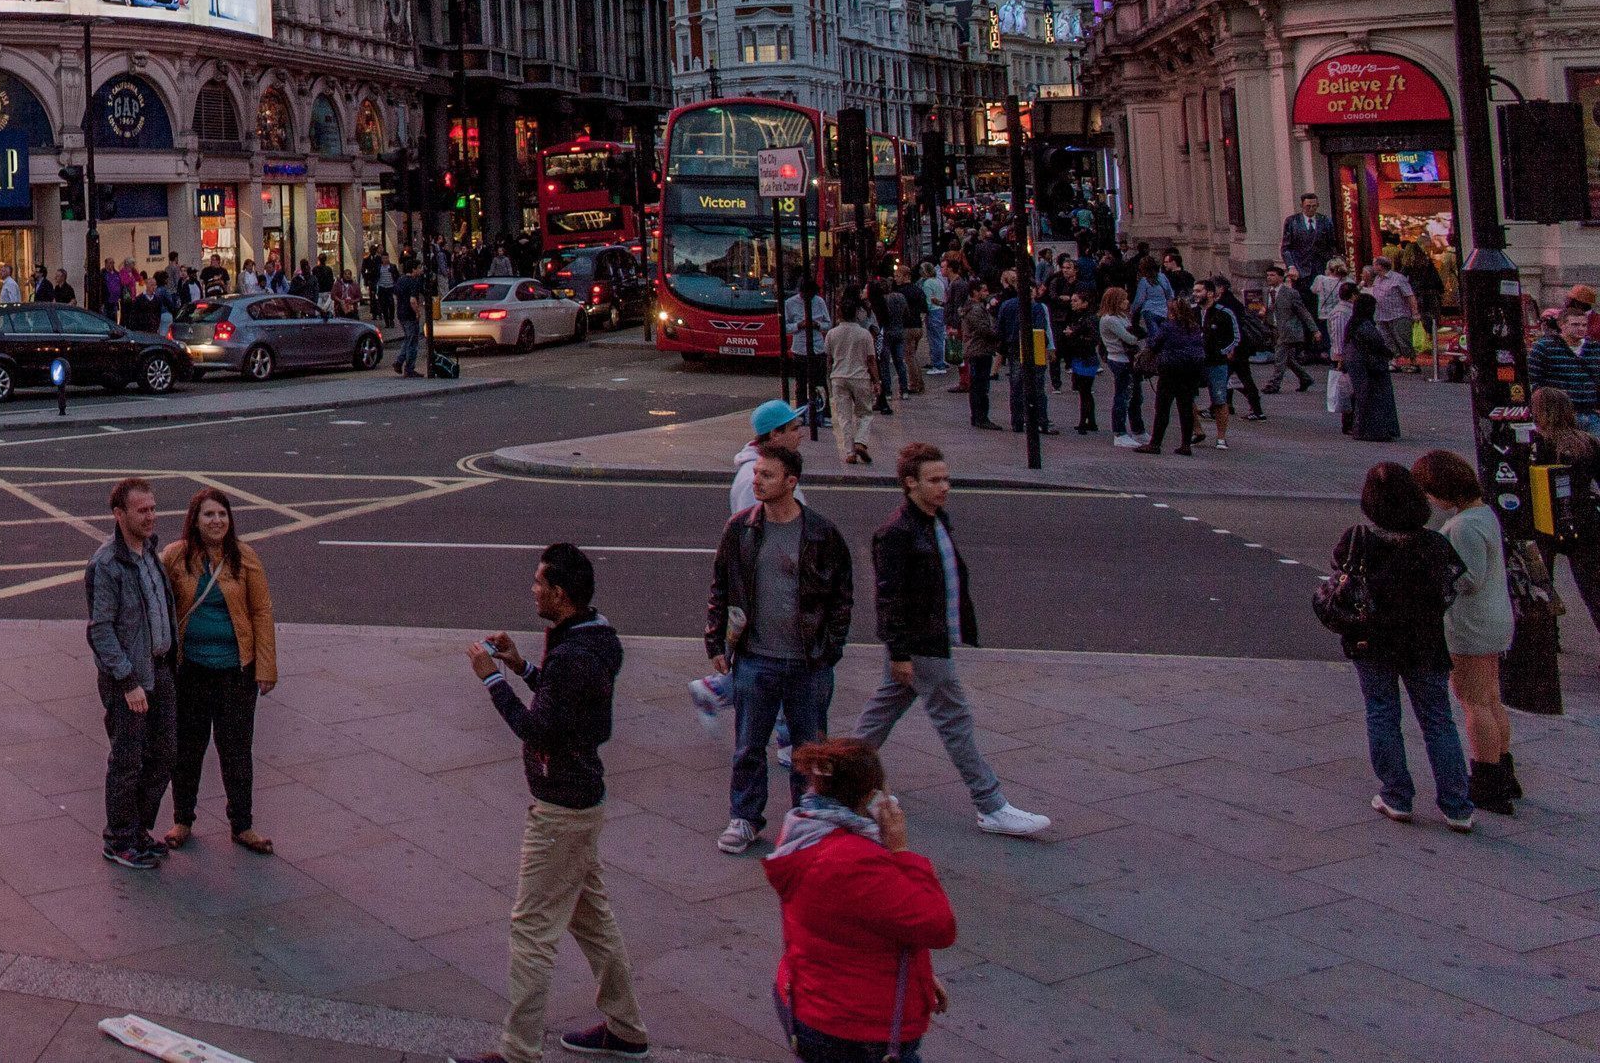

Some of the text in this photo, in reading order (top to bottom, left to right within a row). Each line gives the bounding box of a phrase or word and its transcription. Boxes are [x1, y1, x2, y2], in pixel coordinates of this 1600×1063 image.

[989, 9, 1000, 49] LYRIC
[1316, 74, 1407, 95] Believe It
[114, 96, 140, 119] GAP
[1327, 92, 1393, 113] or Not!
[1343, 112, 1378, 120] LONDON
[767, 153, 777, 166] City
[1380, 152, 1419, 164] Exciting!
[200, 193, 221, 212] GAP
[699, 195, 747, 209] Victoria
[725, 337, 759, 346] ARRIVA
